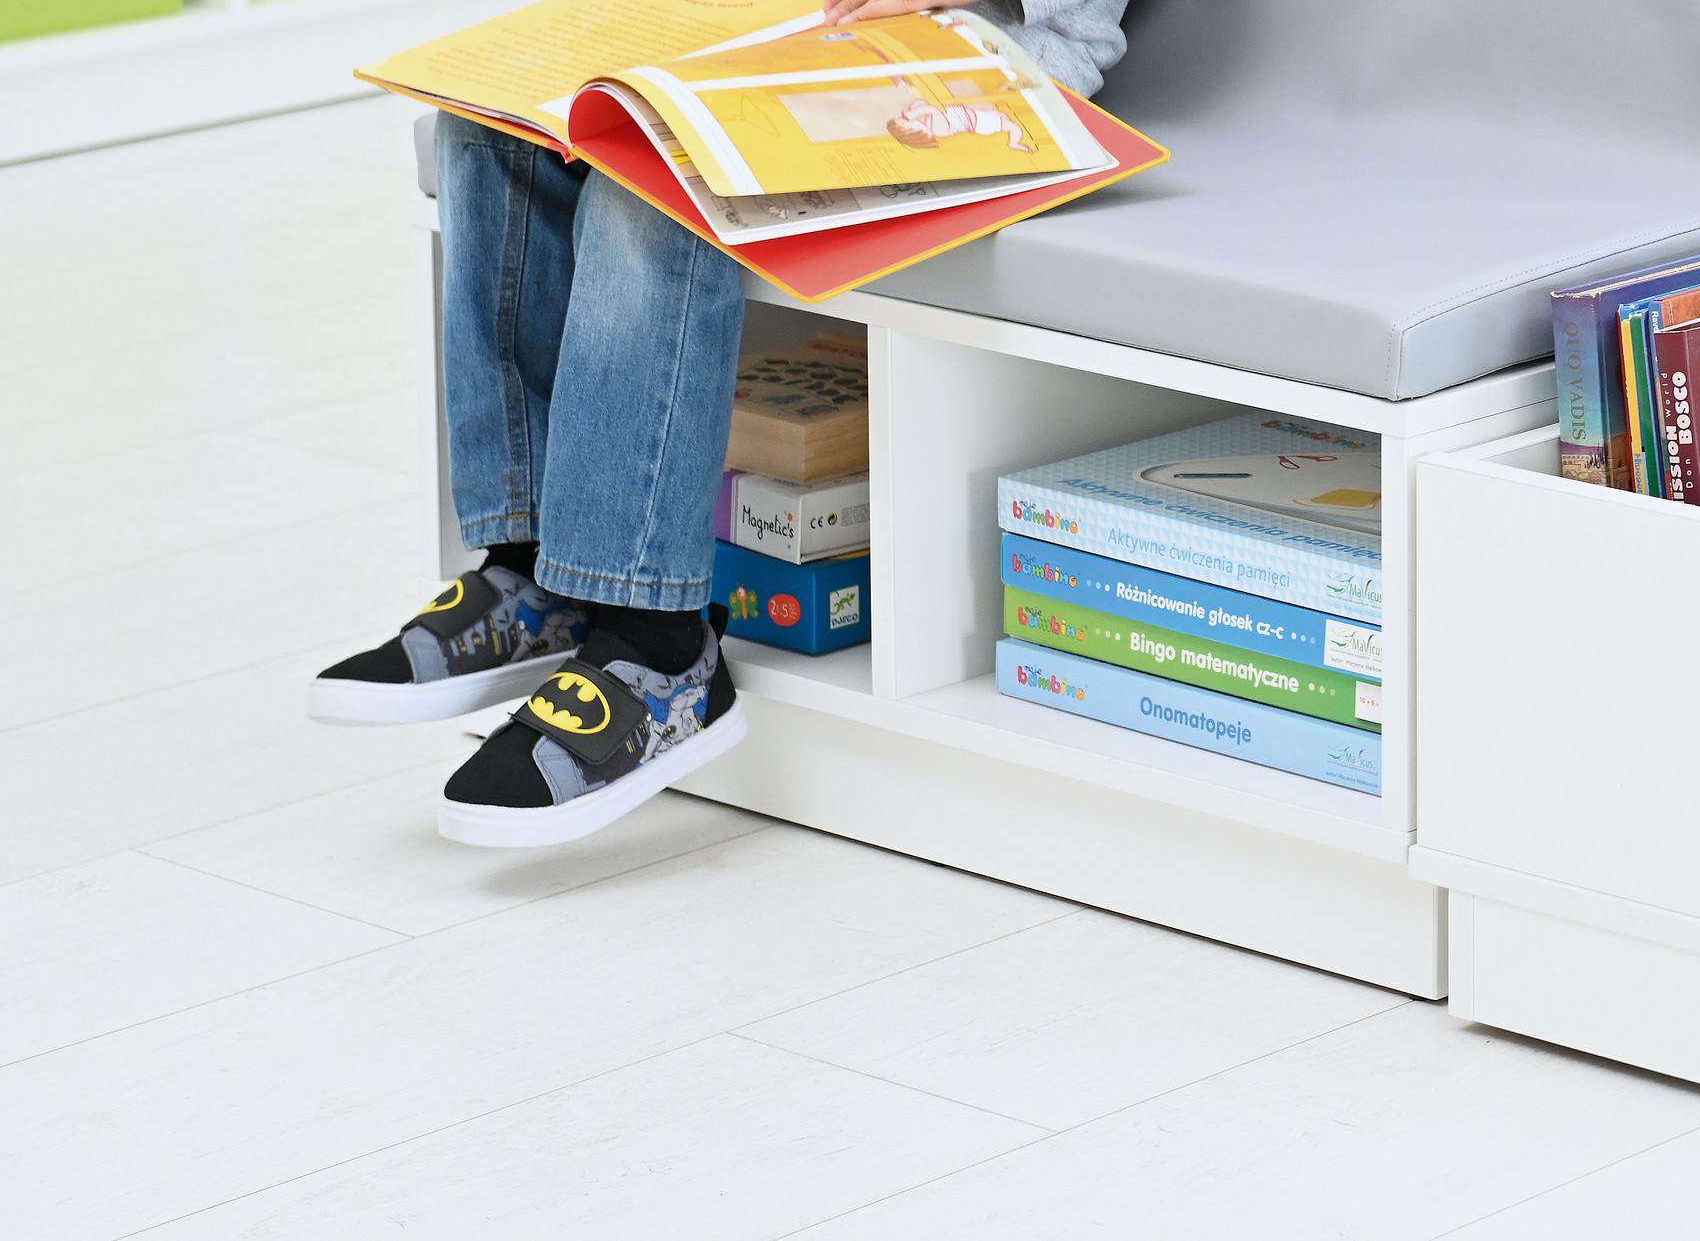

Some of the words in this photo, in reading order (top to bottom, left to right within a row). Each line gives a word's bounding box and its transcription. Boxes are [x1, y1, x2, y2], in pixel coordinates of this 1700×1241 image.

[1562, 321, 1582, 371] QUO
[1568, 381, 1586, 441] VADIS
[1660, 372, 1672, 418] World
[1672, 371, 1693, 445] BOSCO
[1665, 425, 1684, 503] ISSION
[1685, 458, 1694, 489] Don
[742, 504, 794, 541] Magnetic's
[1012, 501, 1079, 535] bambino
[1057, 476, 1164, 506] Aktywne
[1165, 503, 1287, 537] ćwiczenia
[1012, 553, 1079, 589] bambino
[1107, 527, 1166, 557] Aktywne
[1168, 543, 1234, 574] ćwiczenia
[1236, 562, 1291, 589] pamięci
[1017, 607, 1085, 641] bambino
[1116, 581, 1205, 620] Różnicowanie
[1208, 608, 1253, 633] głosek
[1256, 622, 1284, 641] cz-c
[1017, 665, 1086, 701] bambino
[1130, 631, 1176, 663] Bingo
[1180, 647, 1299, 693] matematyczne
[1139, 696, 1252, 746] Onomatopeje
